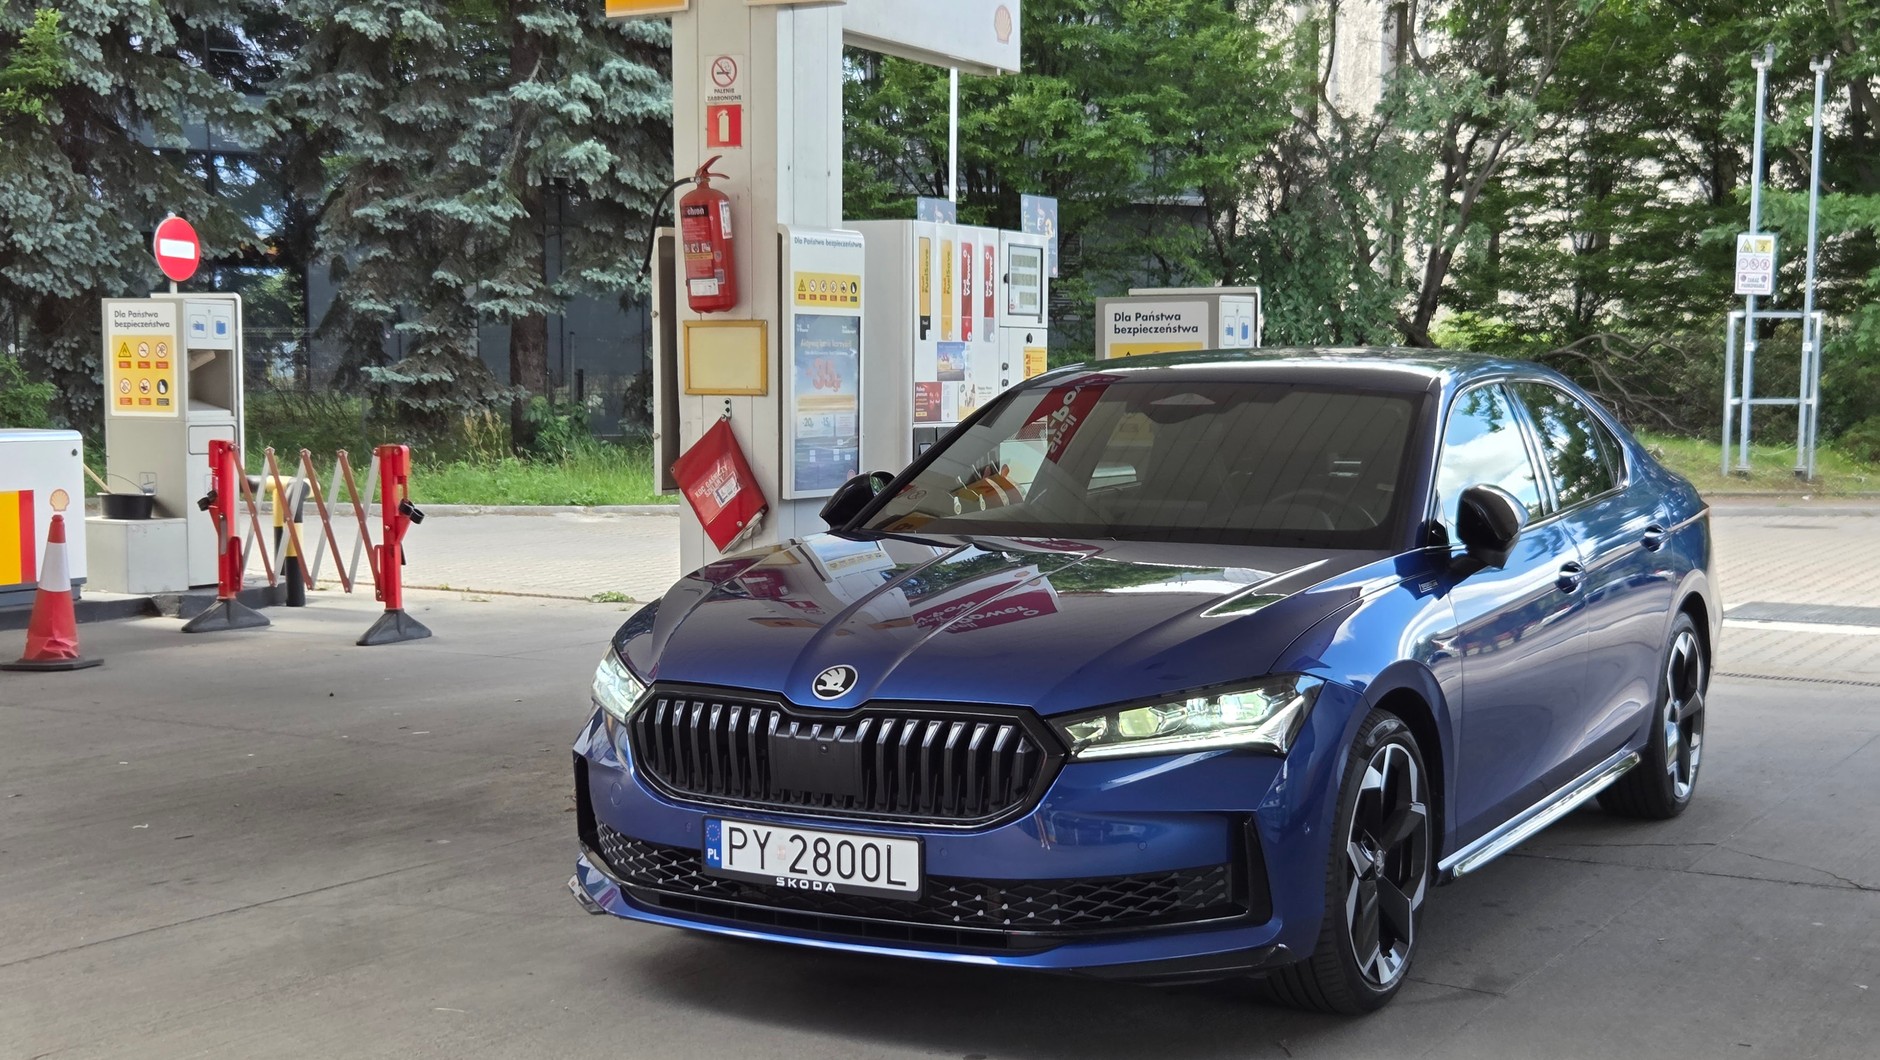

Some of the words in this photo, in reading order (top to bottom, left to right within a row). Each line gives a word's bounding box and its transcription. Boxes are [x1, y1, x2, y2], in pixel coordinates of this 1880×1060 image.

[794, 236, 803, 244] Dla
[114, 310, 126, 318] Dla
[127, 309, 158, 318] Państwa
[1114, 312, 1132, 322] Dla
[1135, 310, 1181, 322] Państwa
[114, 320, 170, 330] bezpieczeństwa
[1114, 324, 1199, 337] bezpieczeństwa
[707, 848, 720, 861] PL
[728, 826, 772, 870] PY
[788, 834, 907, 887] 2800L
